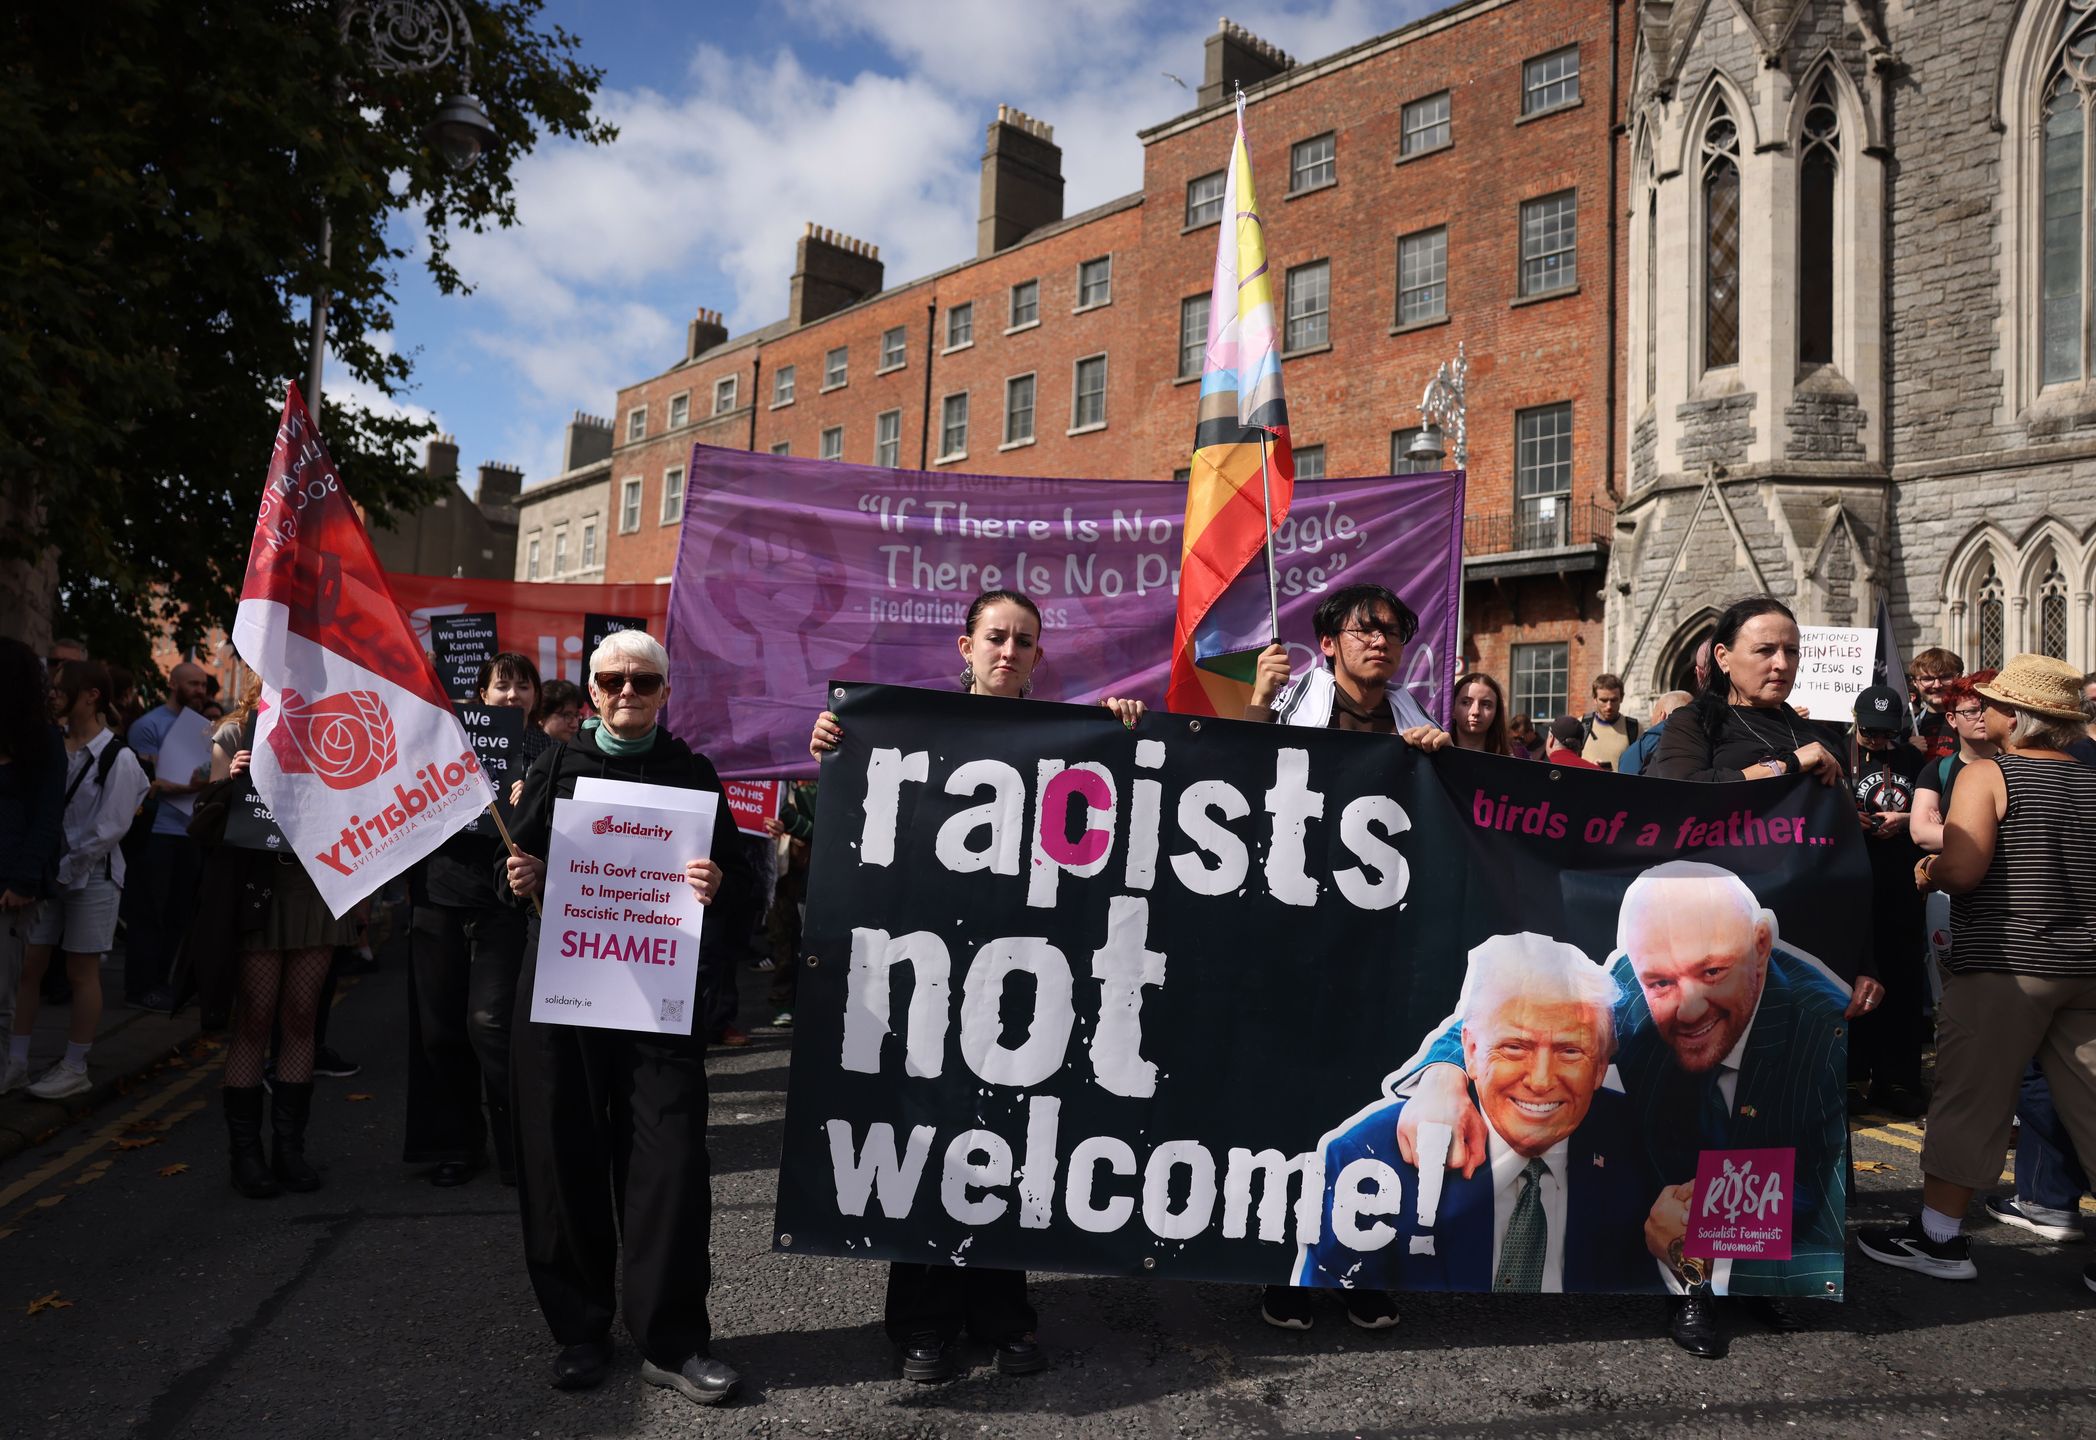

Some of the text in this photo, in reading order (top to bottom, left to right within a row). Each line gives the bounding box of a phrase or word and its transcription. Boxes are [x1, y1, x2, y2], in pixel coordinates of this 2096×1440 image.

[925, 501, 1050, 541] There
[1063, 507, 1100, 543] Is
[1112, 509, 1172, 545] No
[1275, 501, 1368, 554] ggle,
[878, 544, 1003, 592] There
[1016, 552, 1052, 595] Is
[1064, 553, 1123, 598] No
[870, 598, 967, 625] Frederick
[438, 629, 493, 640] We Believe
[607, 621, 625, 632] We
[1799, 633, 1859, 643] MENTIONED
[449, 642, 484, 651] Karena
[1829, 645, 1862, 658] FILES
[444, 653, 482, 665] Virginia
[457, 666, 480, 675] Amy
[1812, 663, 1845, 673] JESUS
[1852, 665, 1864, 675] IS
[1808, 681, 1830, 690] THE
[1834, 682, 1864, 693] BIBLE
[463, 711, 491, 726] We
[467, 732, 509, 748] lieve
[728, 785, 764, 801] ON HIS
[727, 798, 763, 814] HANDS
[1473, 789, 1568, 839] birds
[1584, 811, 1628, 845] of
[1636, 822, 1661, 847] a
[607, 821, 673, 841] solidarity
[569, 859, 685, 883] Irish Govt craven
[581, 885, 671, 903] to Imperialist
[564, 904, 682, 926] Fascistic Predator
[560, 930, 677, 966] SHAME!
[545, 995, 592, 1008] solidarity.ie
[841, 896, 1168, 1098] not
[826, 1095, 1453, 1255] welcome!
[1702, 1159, 1784, 1223] ROSA
[1698, 1226, 1783, 1240] Socialist Feminist
[1713, 1240, 1765, 1253] Movement
